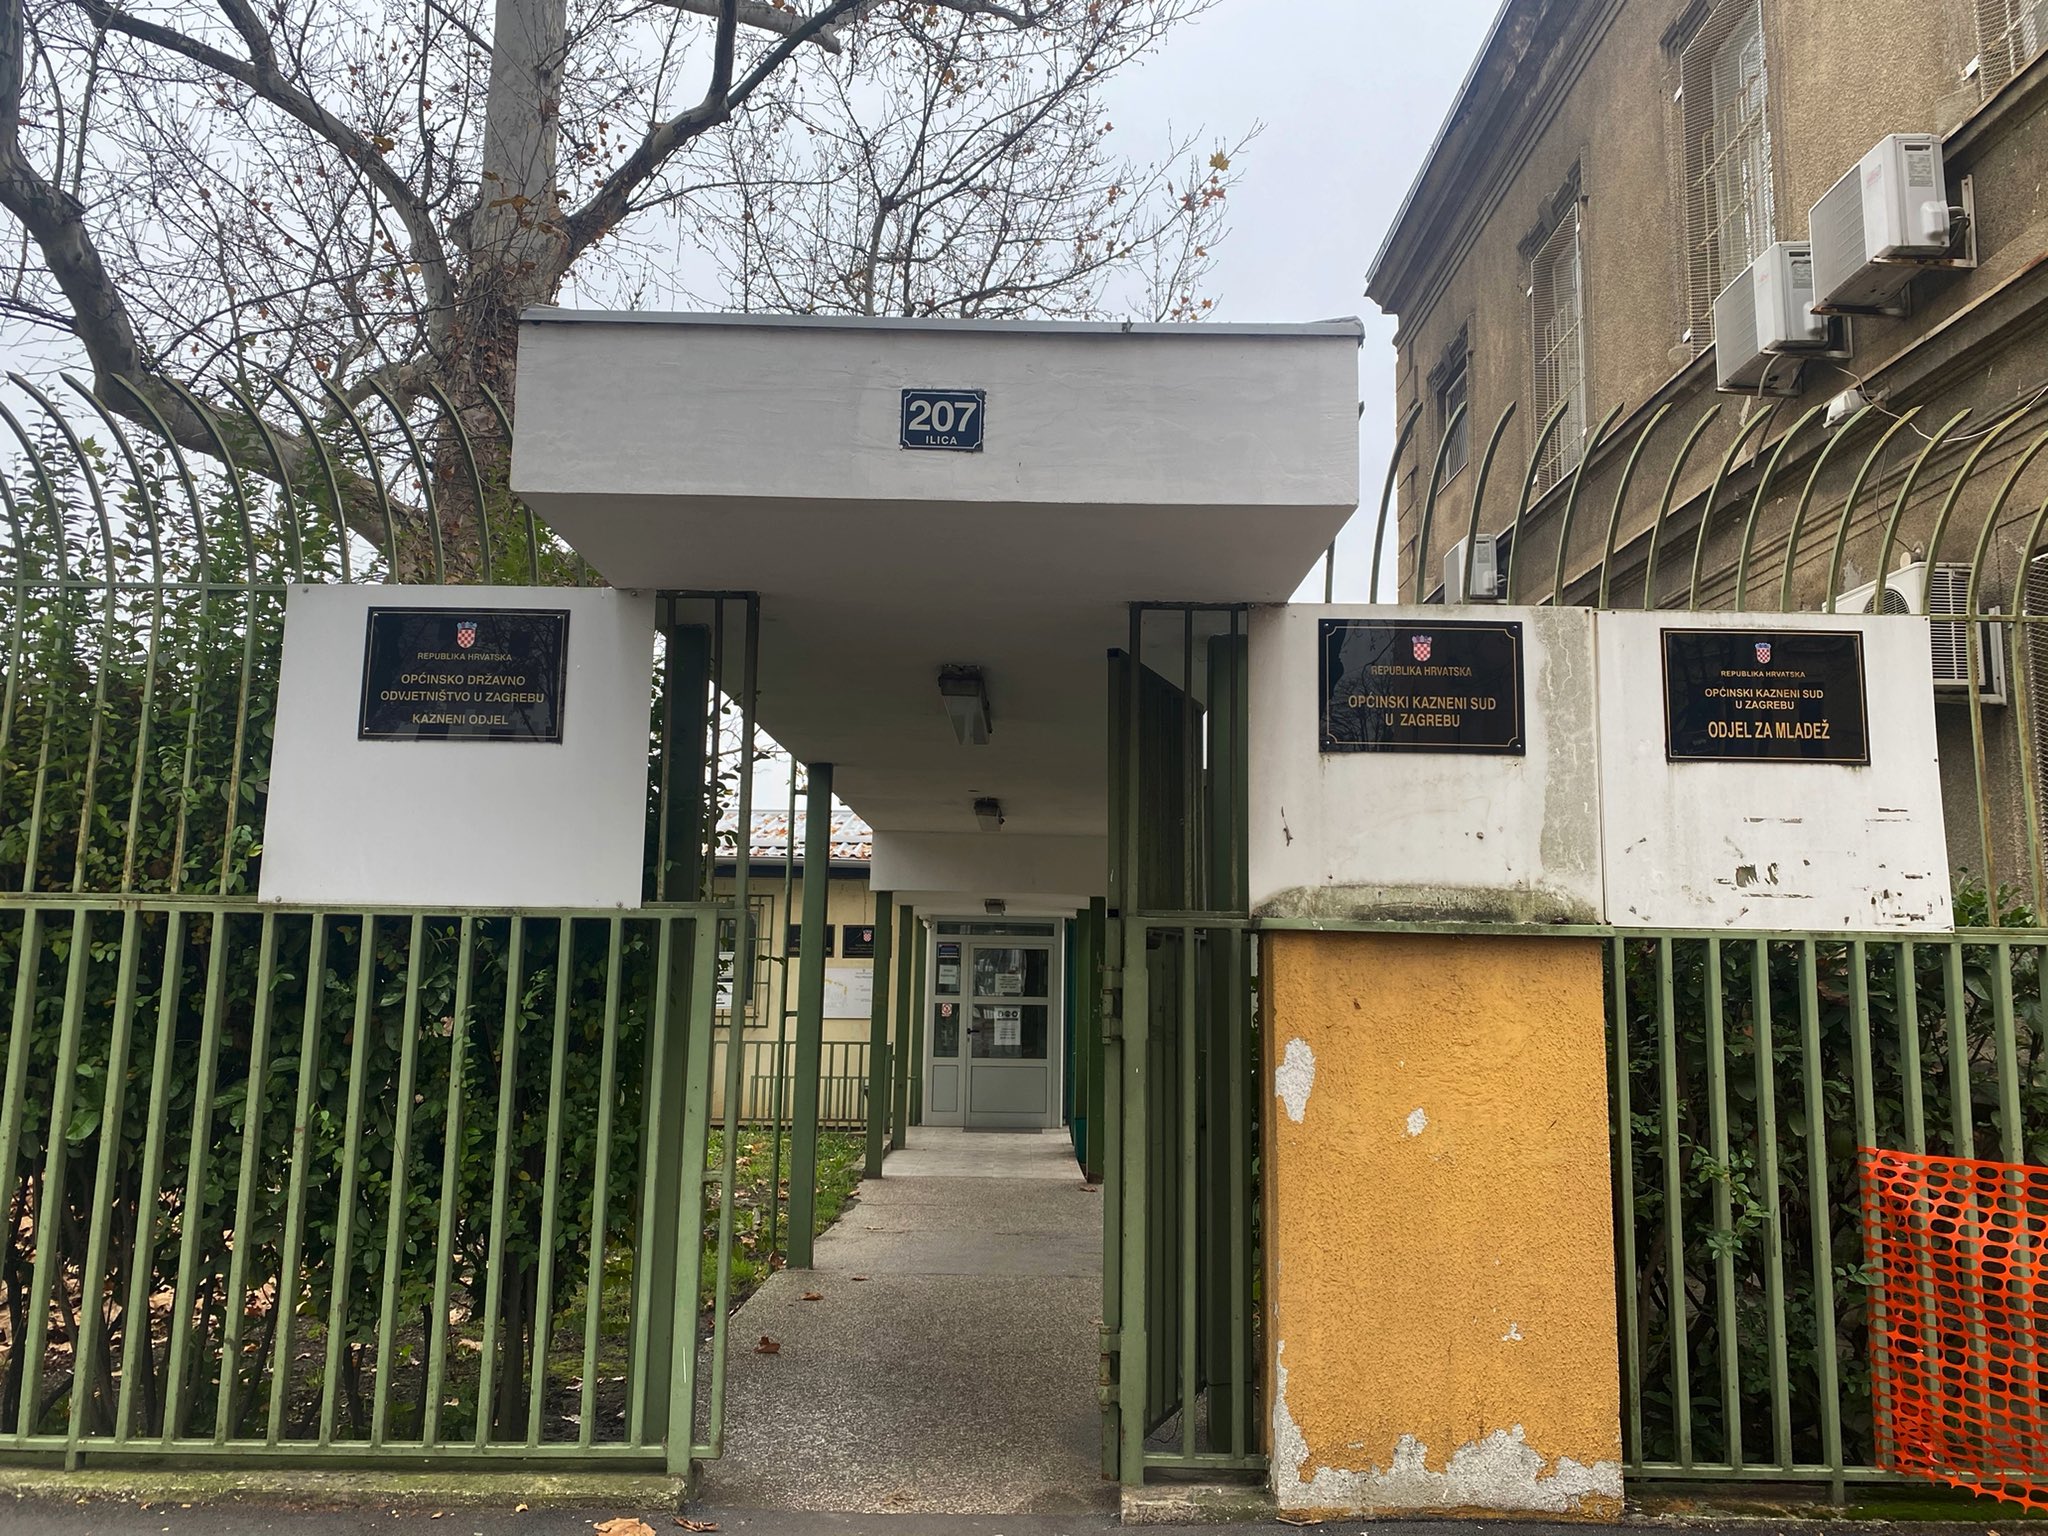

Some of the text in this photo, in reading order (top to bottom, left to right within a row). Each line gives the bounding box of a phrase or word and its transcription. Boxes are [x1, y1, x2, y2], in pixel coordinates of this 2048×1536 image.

[908, 400, 977, 432] 207
[925, 435, 957, 445] ILICA
[417, 652, 512, 662] REPUBLIKA HRVATSKA
[1371, 665, 1473, 677] REPUBLIKA HRVATSKA
[1720, 670, 1764, 678] REPUBLIKA
[401, 672, 526, 686] OPĆINSKO DRŽAVNO
[380, 690, 545, 703] ODVJETNIŠTVO U ZAGREBU
[1704, 687, 1824, 699] OPĆINSKI KAZNENI SUD
[1348, 691, 1496, 710] OPĆINSKI KAZNENI SUD
[1735, 700, 1795, 710] U ZAGREBU
[412, 714, 509, 725] KAZNENI ODJEL
[1385, 713, 1461, 727] U ZAGREBU
[1708, 718, 1830, 740] ODJEL ZA MLADEŽ
